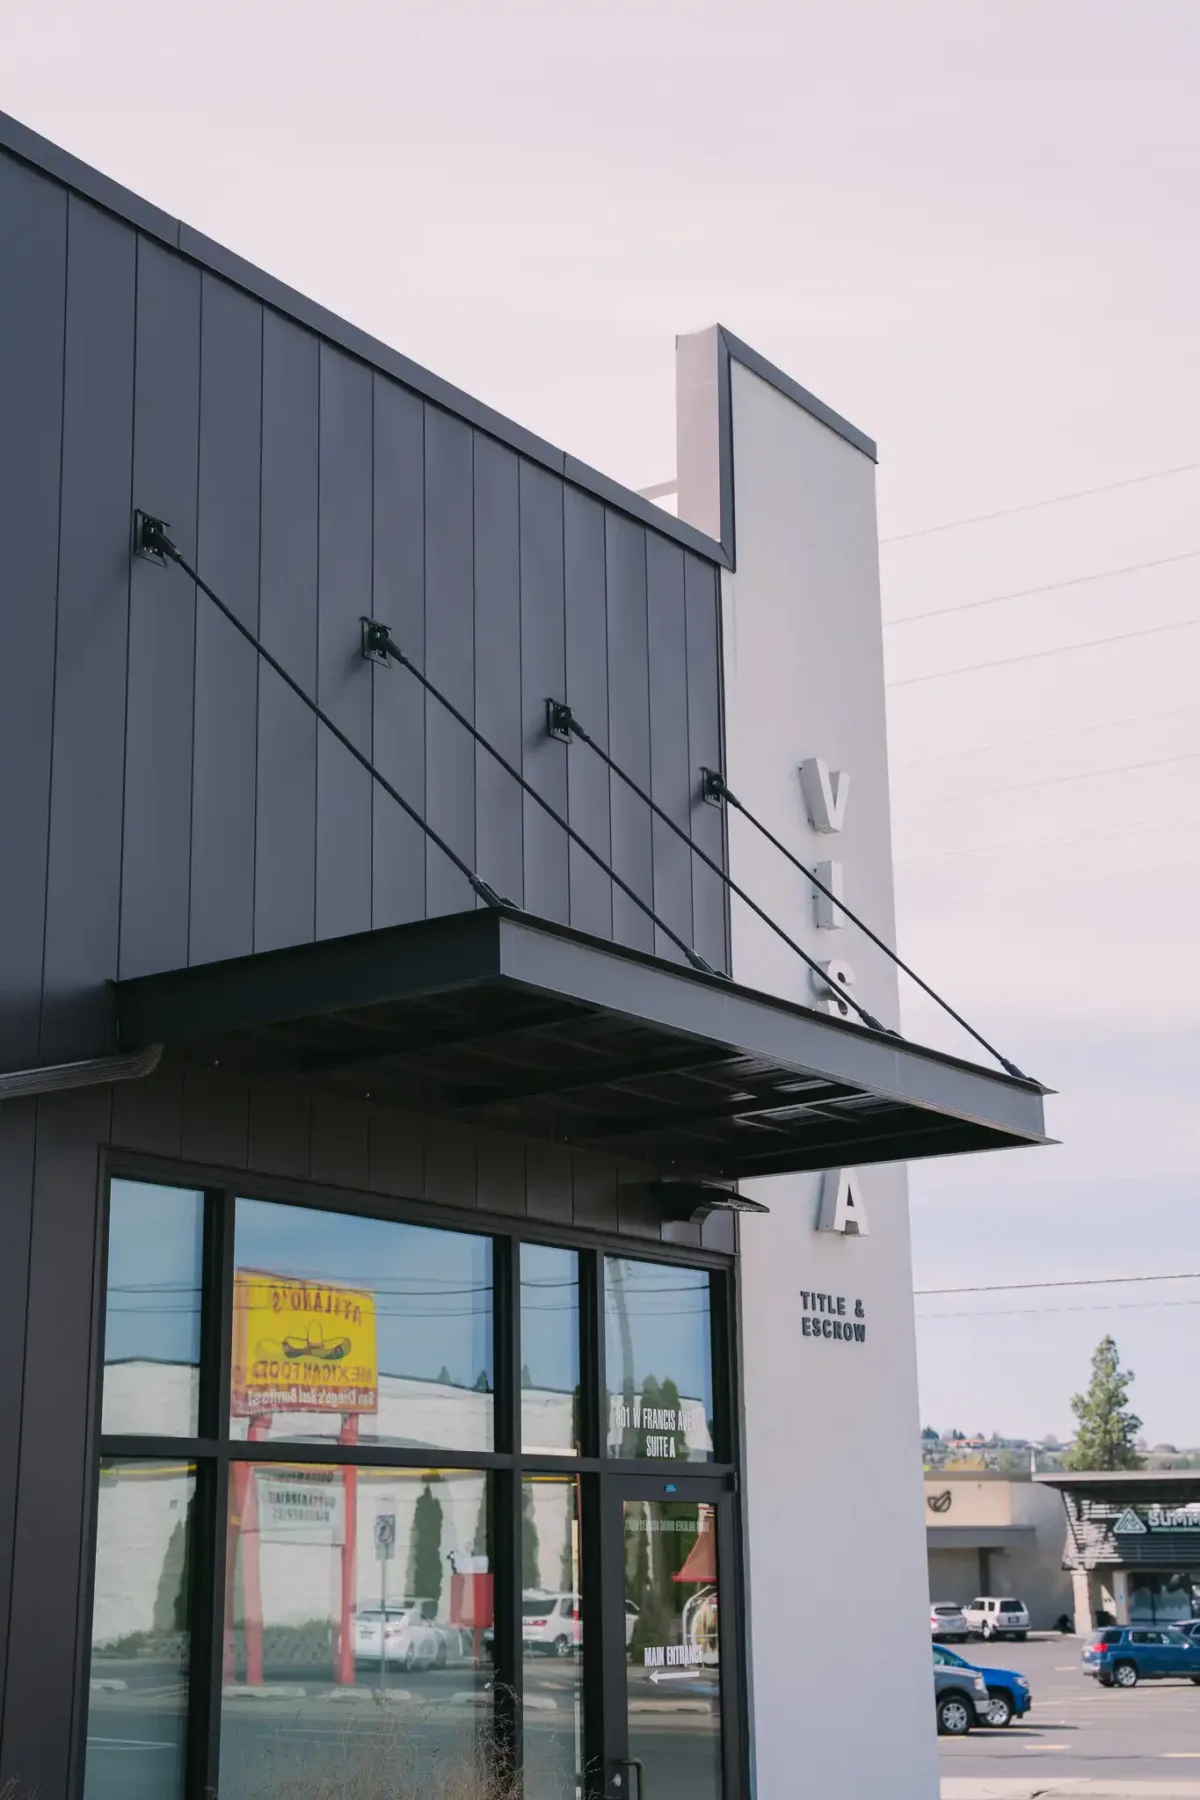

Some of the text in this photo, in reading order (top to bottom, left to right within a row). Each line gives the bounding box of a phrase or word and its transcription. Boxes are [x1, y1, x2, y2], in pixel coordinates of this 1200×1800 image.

[800, 757, 870, 1237] VISA
[800, 1291, 865, 1318] TITLE &
[801, 1316, 866, 1343] ESCROW
[633, 1407, 641, 1429] W
[643, 1408, 676, 1431] FRANCIS
[646, 1435, 676, 1458] SUITE A
[644, 1646, 665, 1668] MAIN
